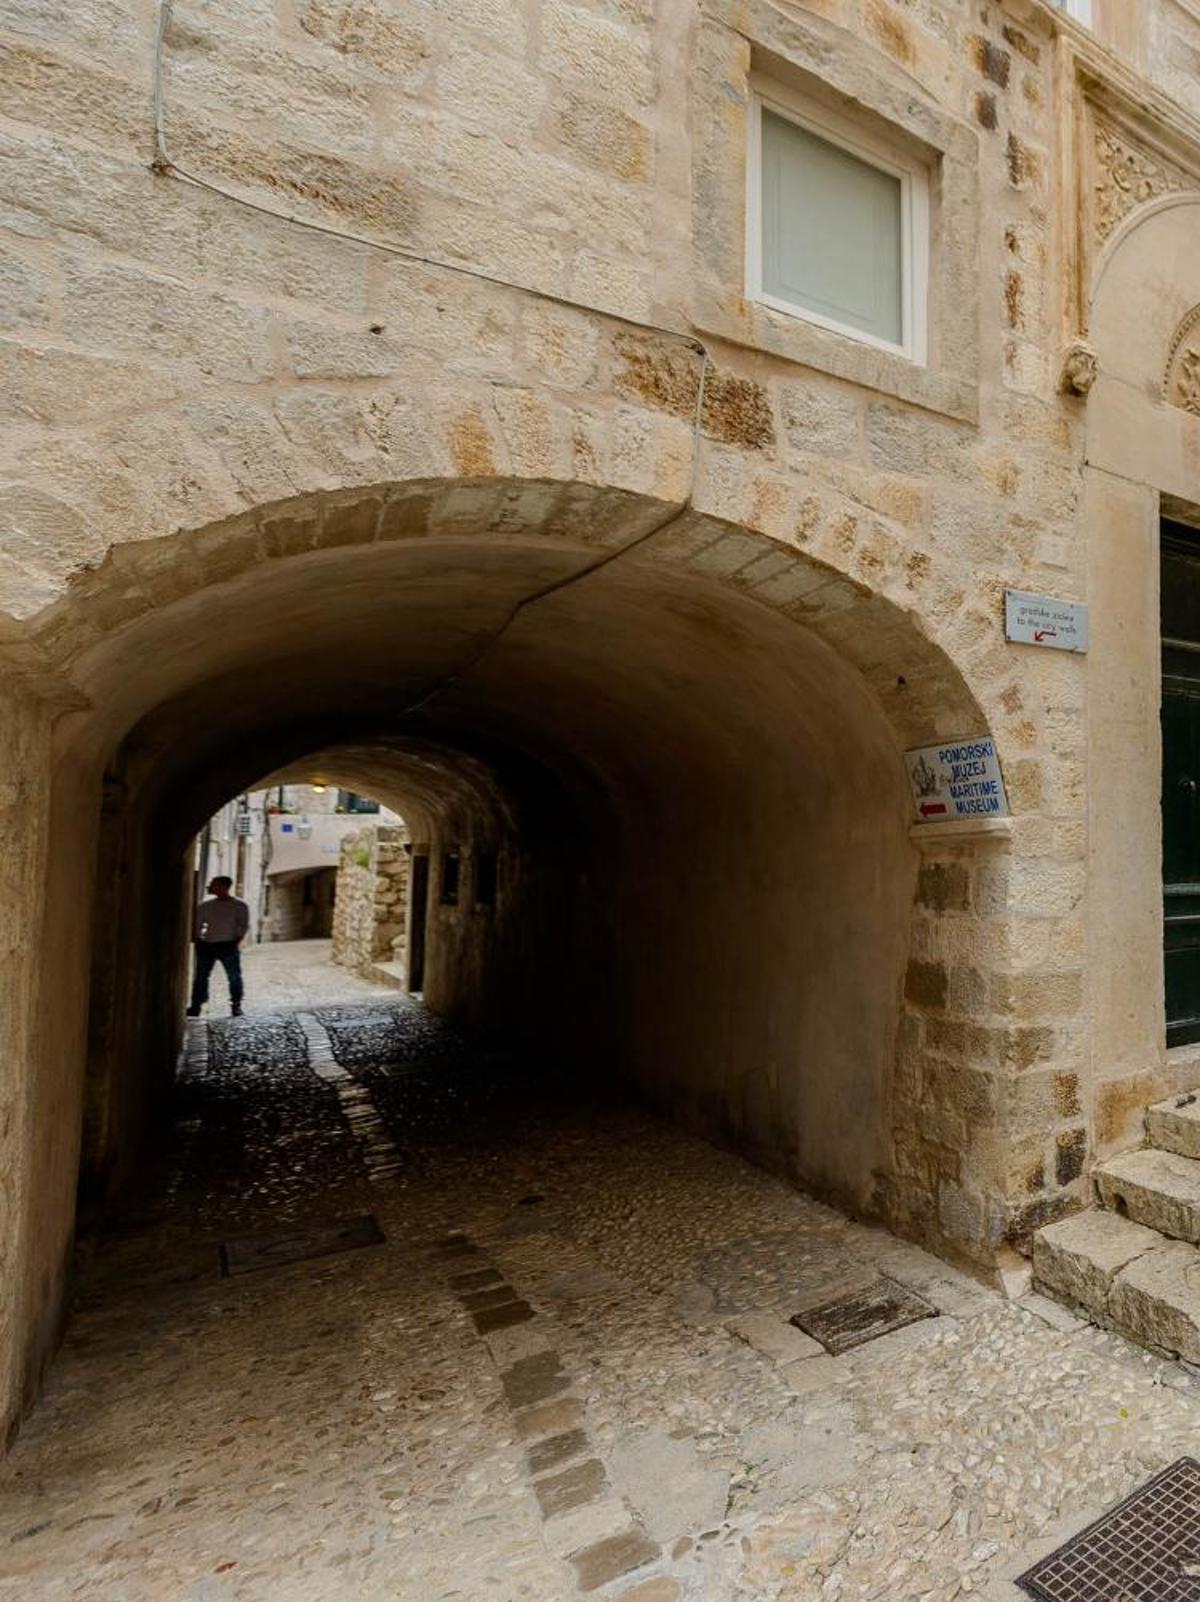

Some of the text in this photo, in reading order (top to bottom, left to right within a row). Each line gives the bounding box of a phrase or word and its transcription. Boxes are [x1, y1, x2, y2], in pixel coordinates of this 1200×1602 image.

[1017, 616, 1026, 625] to
[939, 742, 994, 764] POMORSKI
[951, 761, 986, 779] MUZEJ
[949, 780, 999, 799] MARITIME
[955, 798, 1000, 814] MUSEUM
